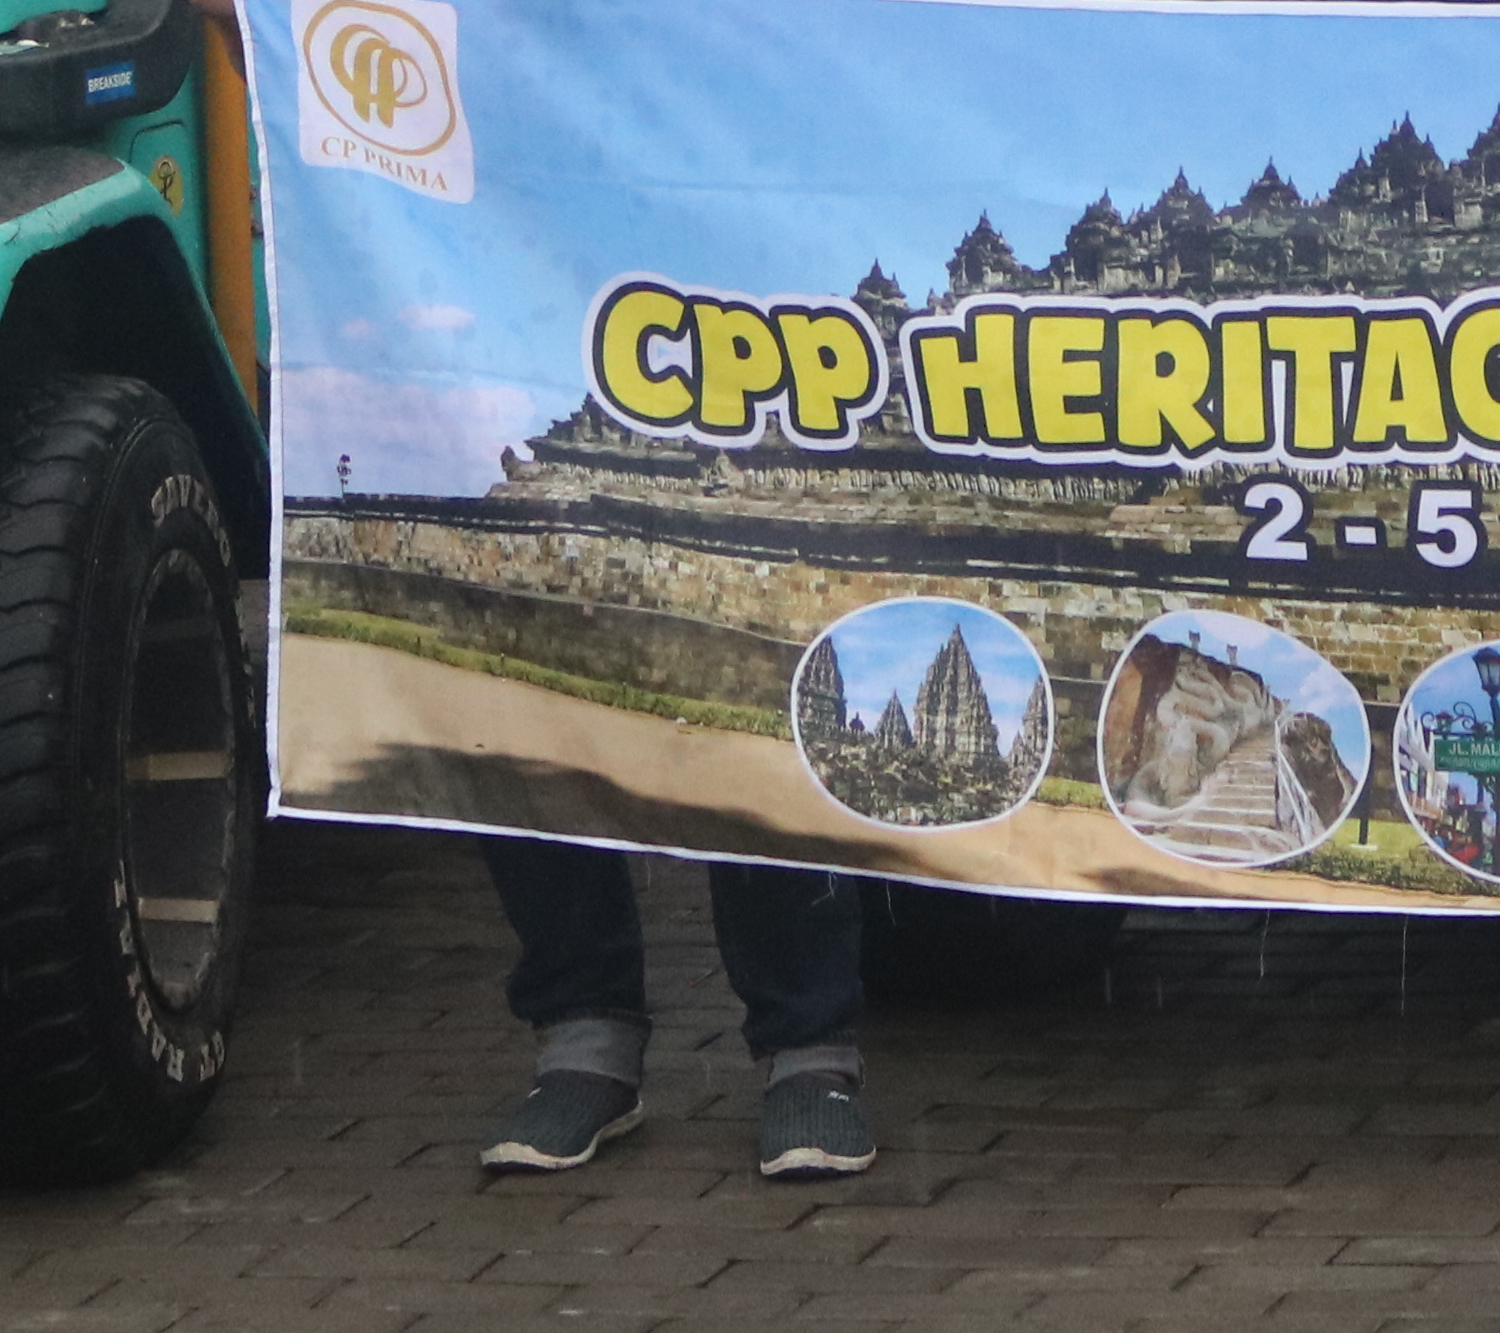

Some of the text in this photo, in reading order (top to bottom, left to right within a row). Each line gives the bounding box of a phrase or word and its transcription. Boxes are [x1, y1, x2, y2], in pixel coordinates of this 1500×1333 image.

[88, 71, 132, 93] BREAKSIDE
[321, 136, 449, 192] CP PRIMA
[599, 285, 875, 433] CPP
[1246, 485, 1305, 560] 2
[1414, 490, 1477, 566] 5
[1449, 743, 1469, 756] JL.
